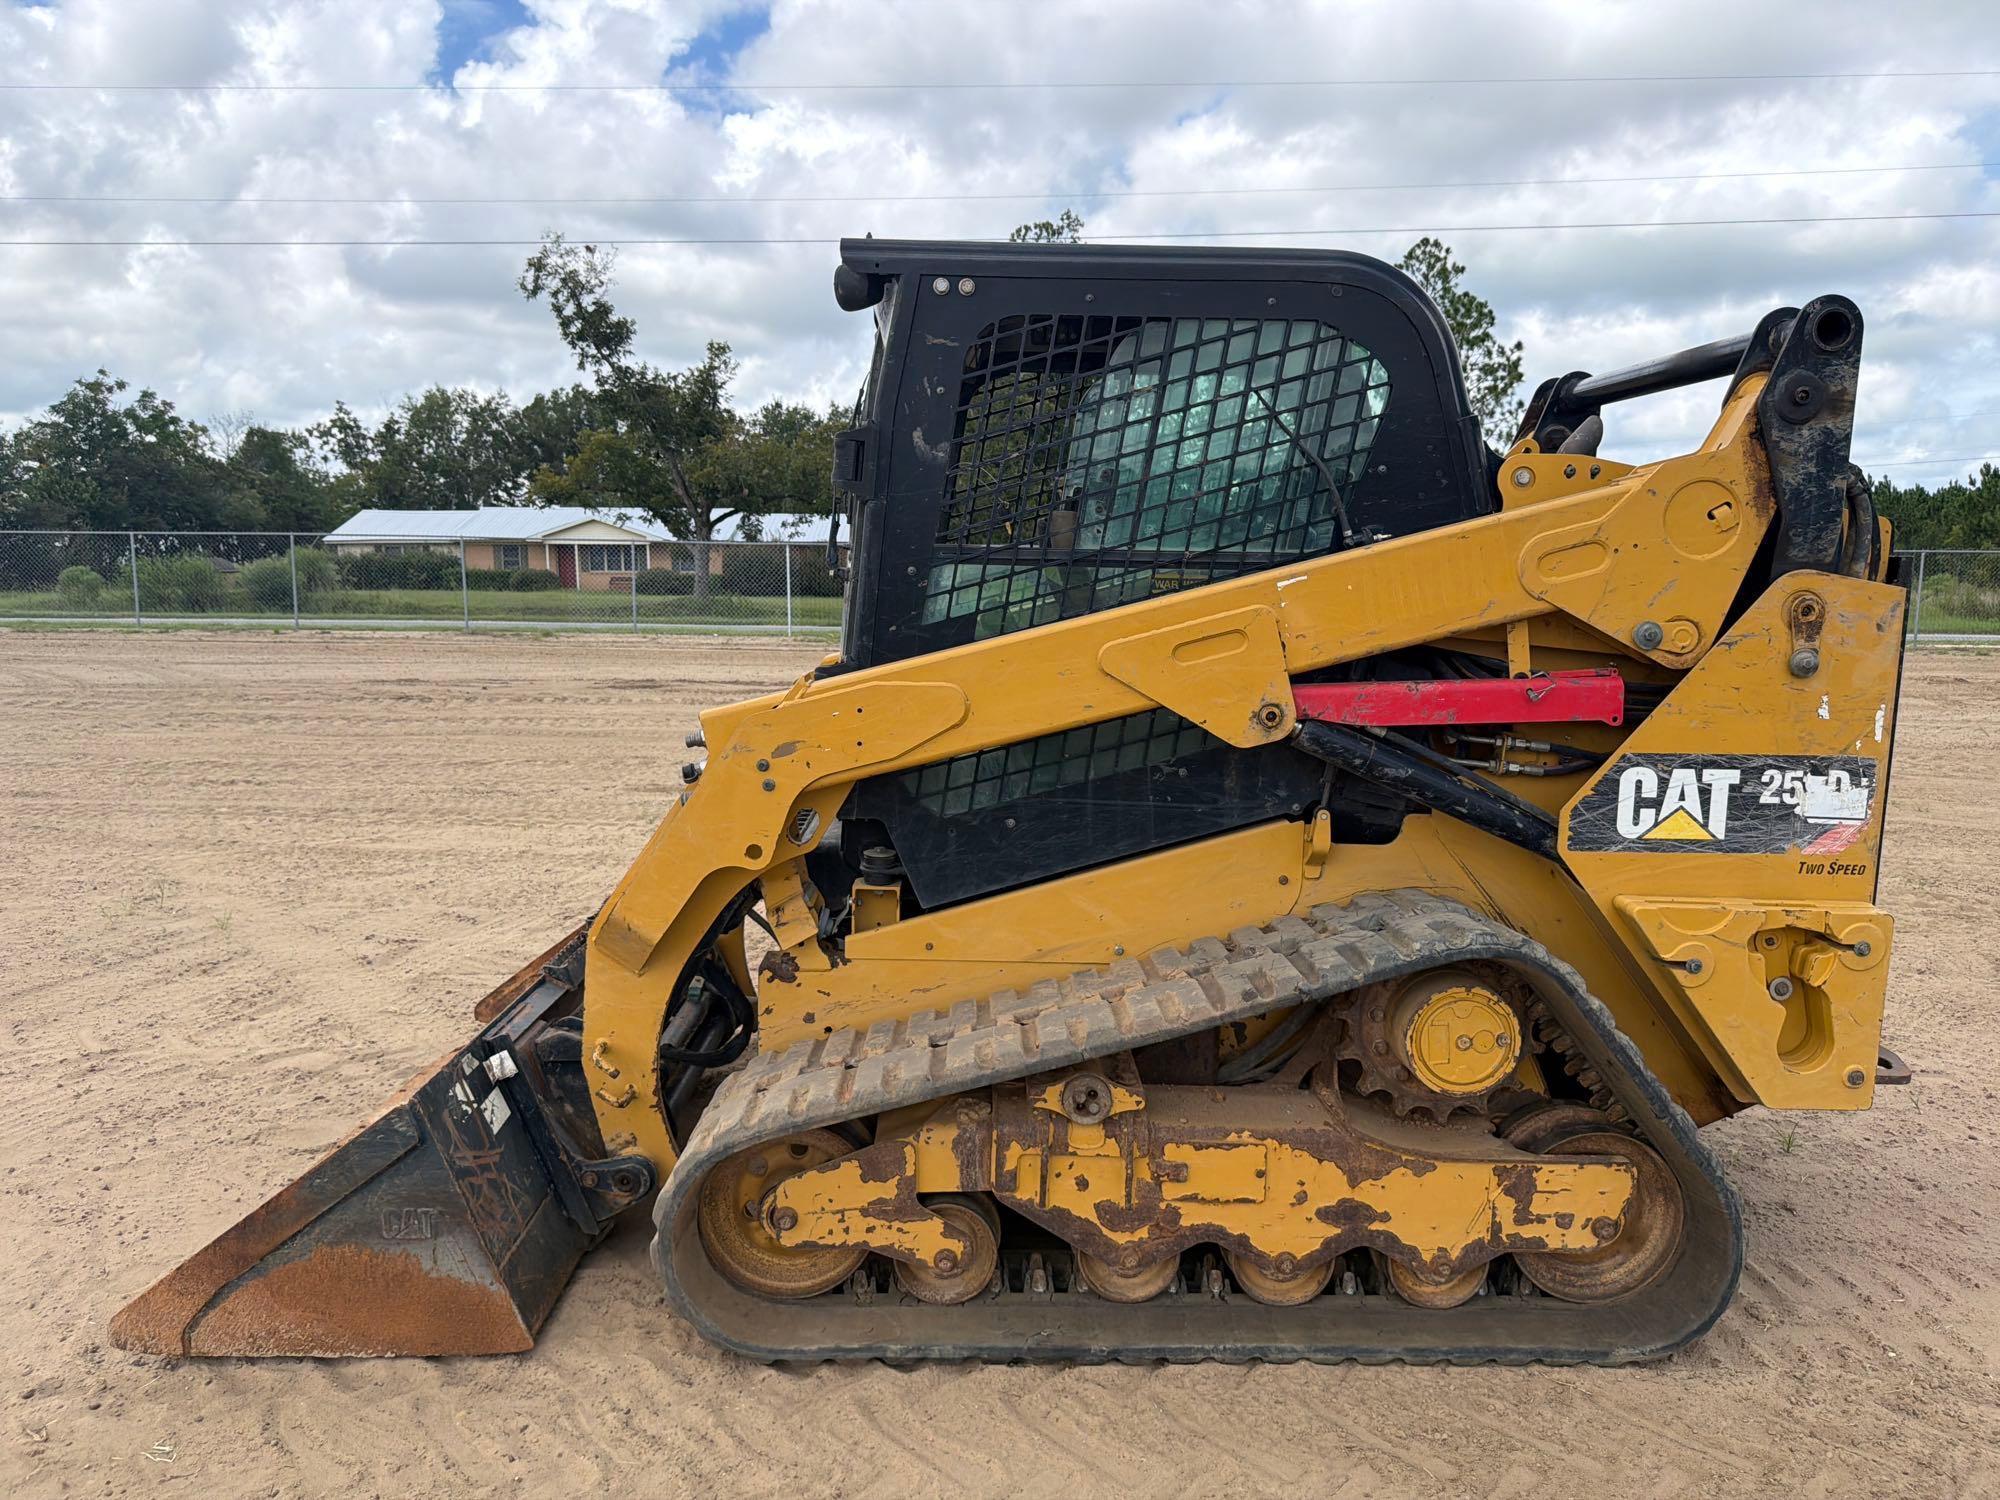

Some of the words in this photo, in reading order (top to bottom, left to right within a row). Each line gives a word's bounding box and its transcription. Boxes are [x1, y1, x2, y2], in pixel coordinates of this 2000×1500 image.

[1616, 766, 1741, 840] CAT
[1759, 769, 1851, 804] 25D
[380, 1207, 434, 1240] CAT
